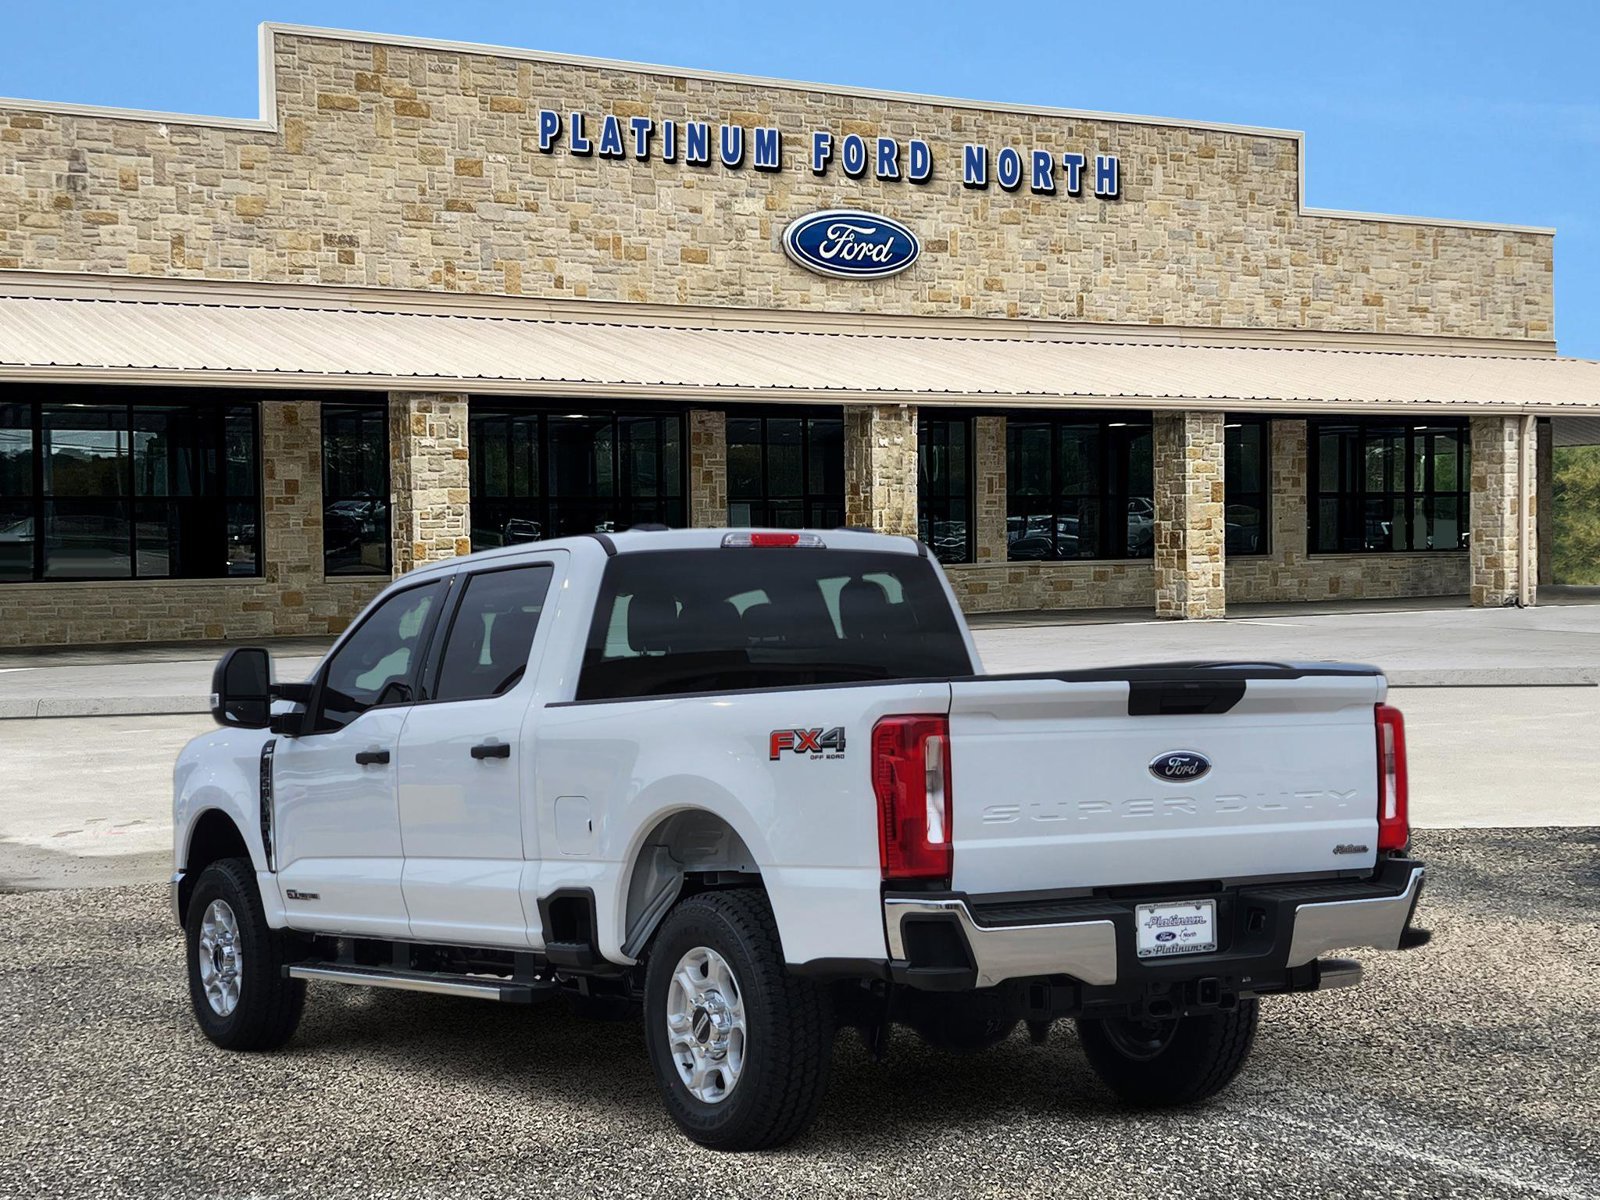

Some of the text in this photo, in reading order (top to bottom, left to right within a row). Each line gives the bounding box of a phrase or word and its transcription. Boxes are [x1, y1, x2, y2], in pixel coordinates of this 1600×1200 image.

[538, 110, 1121, 200] PLATINUM FORD NORTH
[818, 222, 895, 264] Ford
[769, 726, 846, 761] FX4
[1164, 757, 1199, 776] Ford
[983, 788, 1358, 824] SUPER DUTY
[1144, 914, 1207, 929] Platinum
[1154, 943, 1201, 955] Platinum
